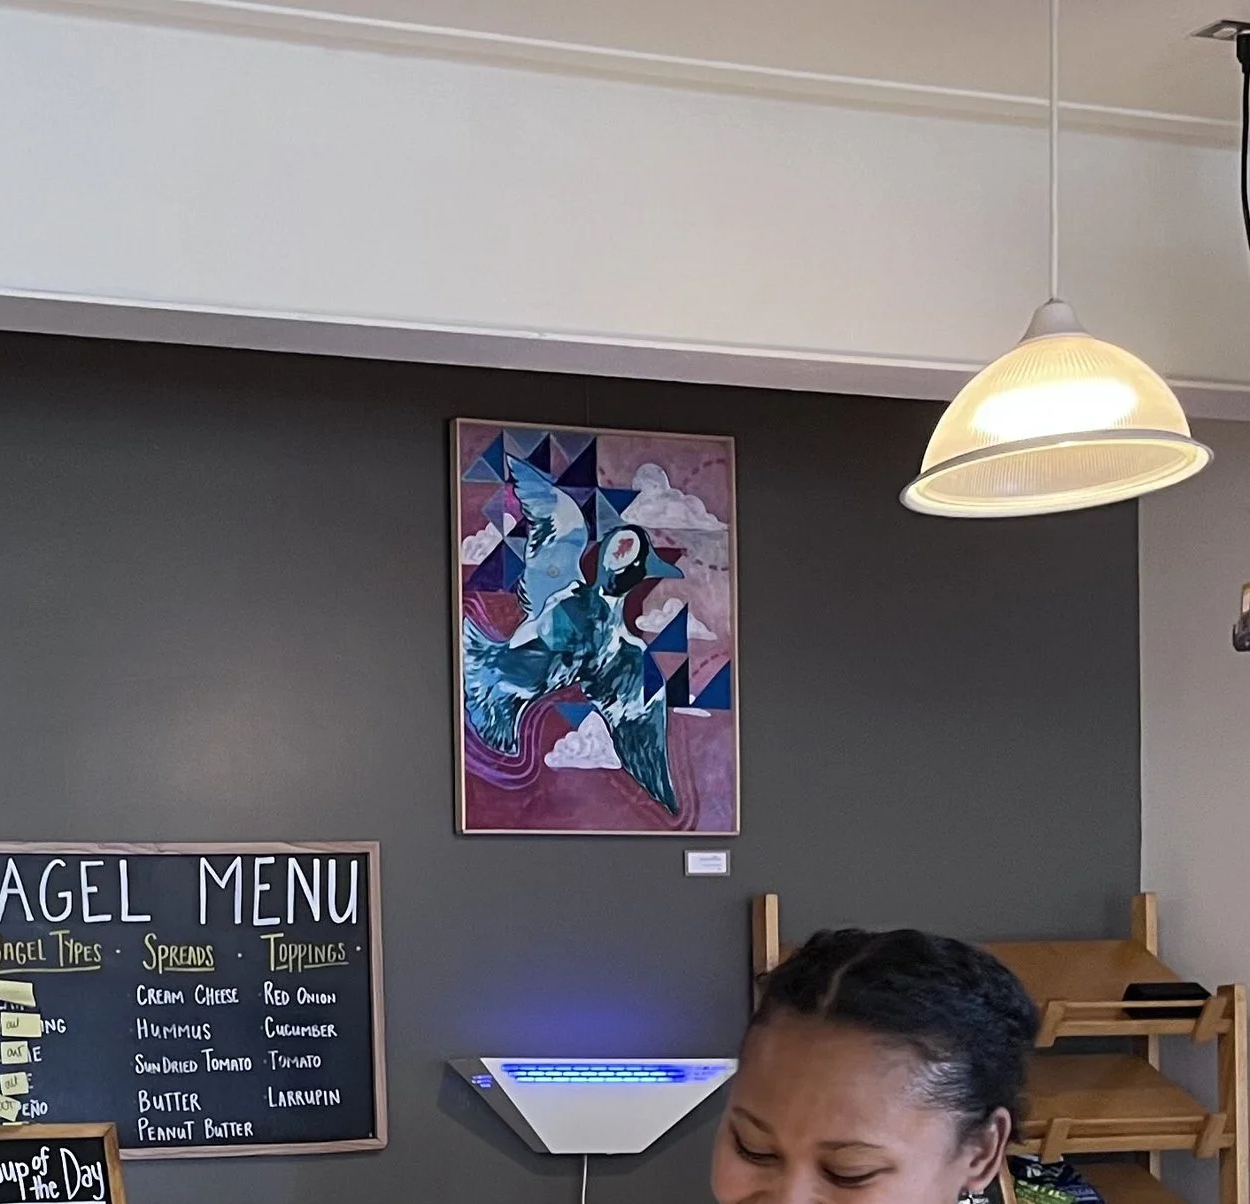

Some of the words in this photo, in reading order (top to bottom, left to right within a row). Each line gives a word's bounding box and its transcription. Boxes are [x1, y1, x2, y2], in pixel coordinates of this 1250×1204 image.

[199, 856, 358, 925] MENU
[50, 930, 101, 964] TYPES
[143, 933, 215, 973] SPREADS
[260, 933, 347, 971] TOPPINGS
[136, 984, 184, 1005] CREAM
[195, 984, 239, 1005] CHEESE
[264, 981, 290, 1005] RED
[297, 987, 336, 1004] ONION
[136, 1018, 211, 1040] HUMMUS
[264, 1016, 337, 1038] CUCUMBER
[201, 1048, 252, 1072] TOMATO
[268, 1050, 321, 1070] TOMATO
[138, 1090, 201, 1112] BUTTER
[268, 1086, 341, 1107] LARRUPIN
[137, 1117, 195, 1141] PEANUT
[204, 1118, 253, 1139] BUTTER
[32, 1146, 50, 1176] of
[59, 1147, 105, 1200] Day
[29, 1175, 60, 1200] the
